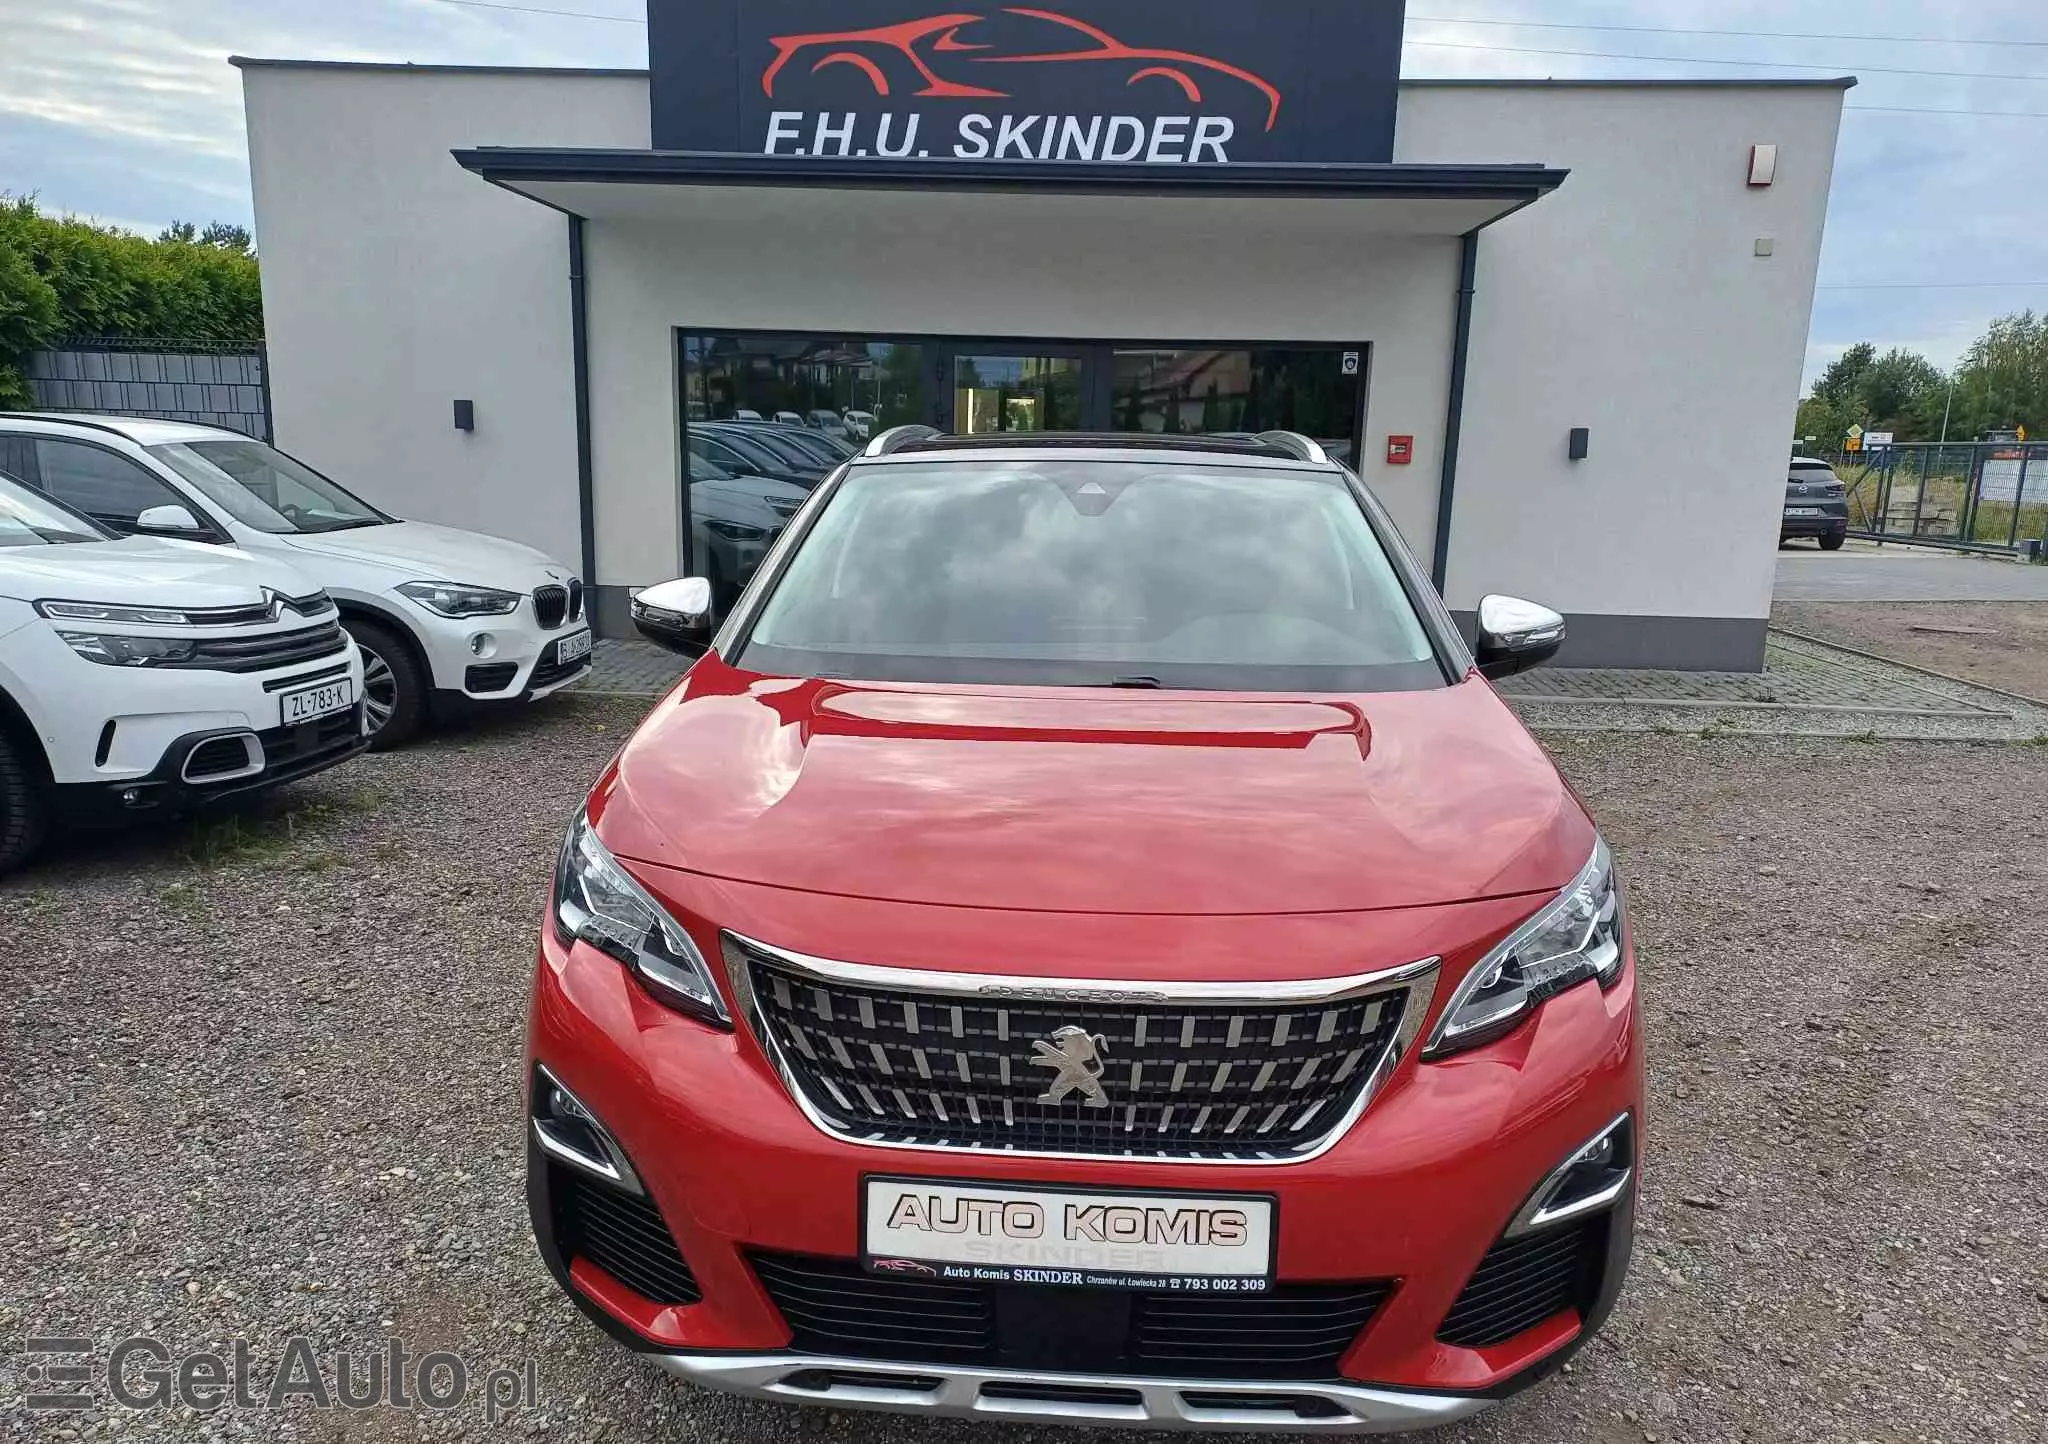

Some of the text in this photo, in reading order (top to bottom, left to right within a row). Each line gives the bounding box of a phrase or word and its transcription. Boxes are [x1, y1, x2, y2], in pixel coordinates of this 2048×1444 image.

[764, 111, 1234, 163] F.H.U. SKINDER
[292, 685, 344, 716] ZL-783-K
[887, 1193, 1248, 1247] AUTO KOMIS
[943, 1265, 971, 1279] Auto
[974, 1267, 1010, 1281] Komis
[1013, 1269, 1083, 1286] SKINDER
[1184, 1278, 1209, 1290] 793
[1212, 1279, 1238, 1291] 002
[1241, 1279, 1266, 1291] 309
